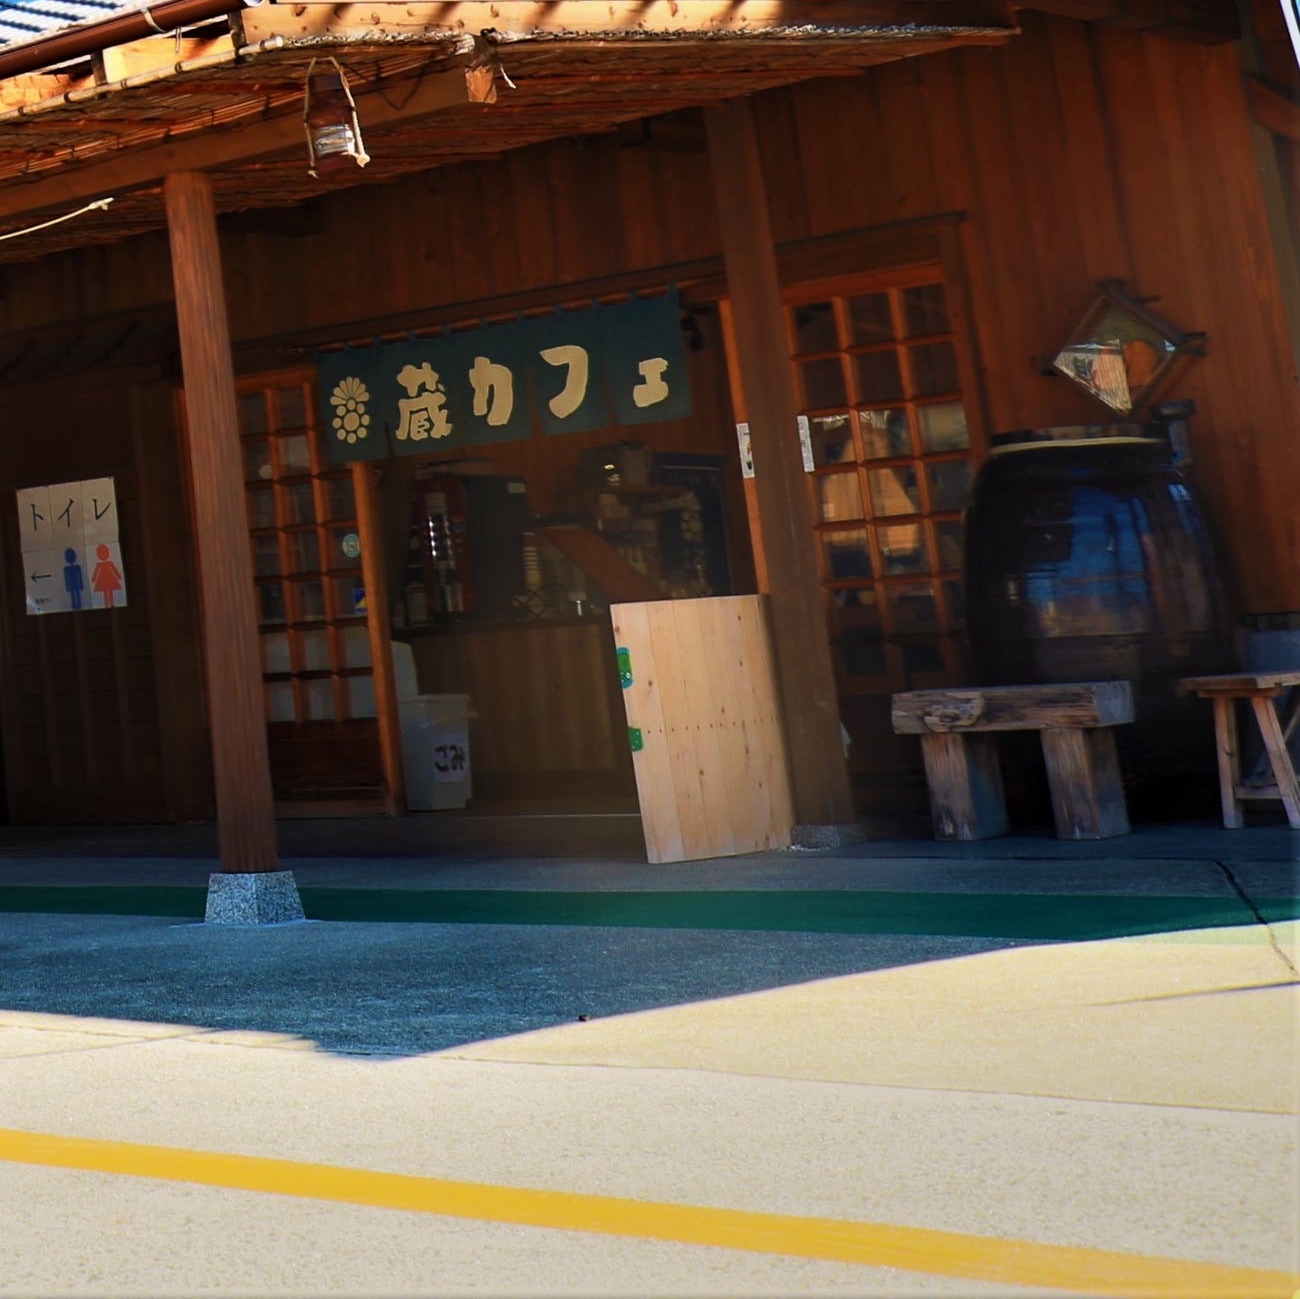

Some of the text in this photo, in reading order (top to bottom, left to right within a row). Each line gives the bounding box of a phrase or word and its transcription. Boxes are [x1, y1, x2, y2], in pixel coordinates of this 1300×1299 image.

[395, 343, 670, 441] 蔵カフェ
[30, 498, 112, 531] トイレ
